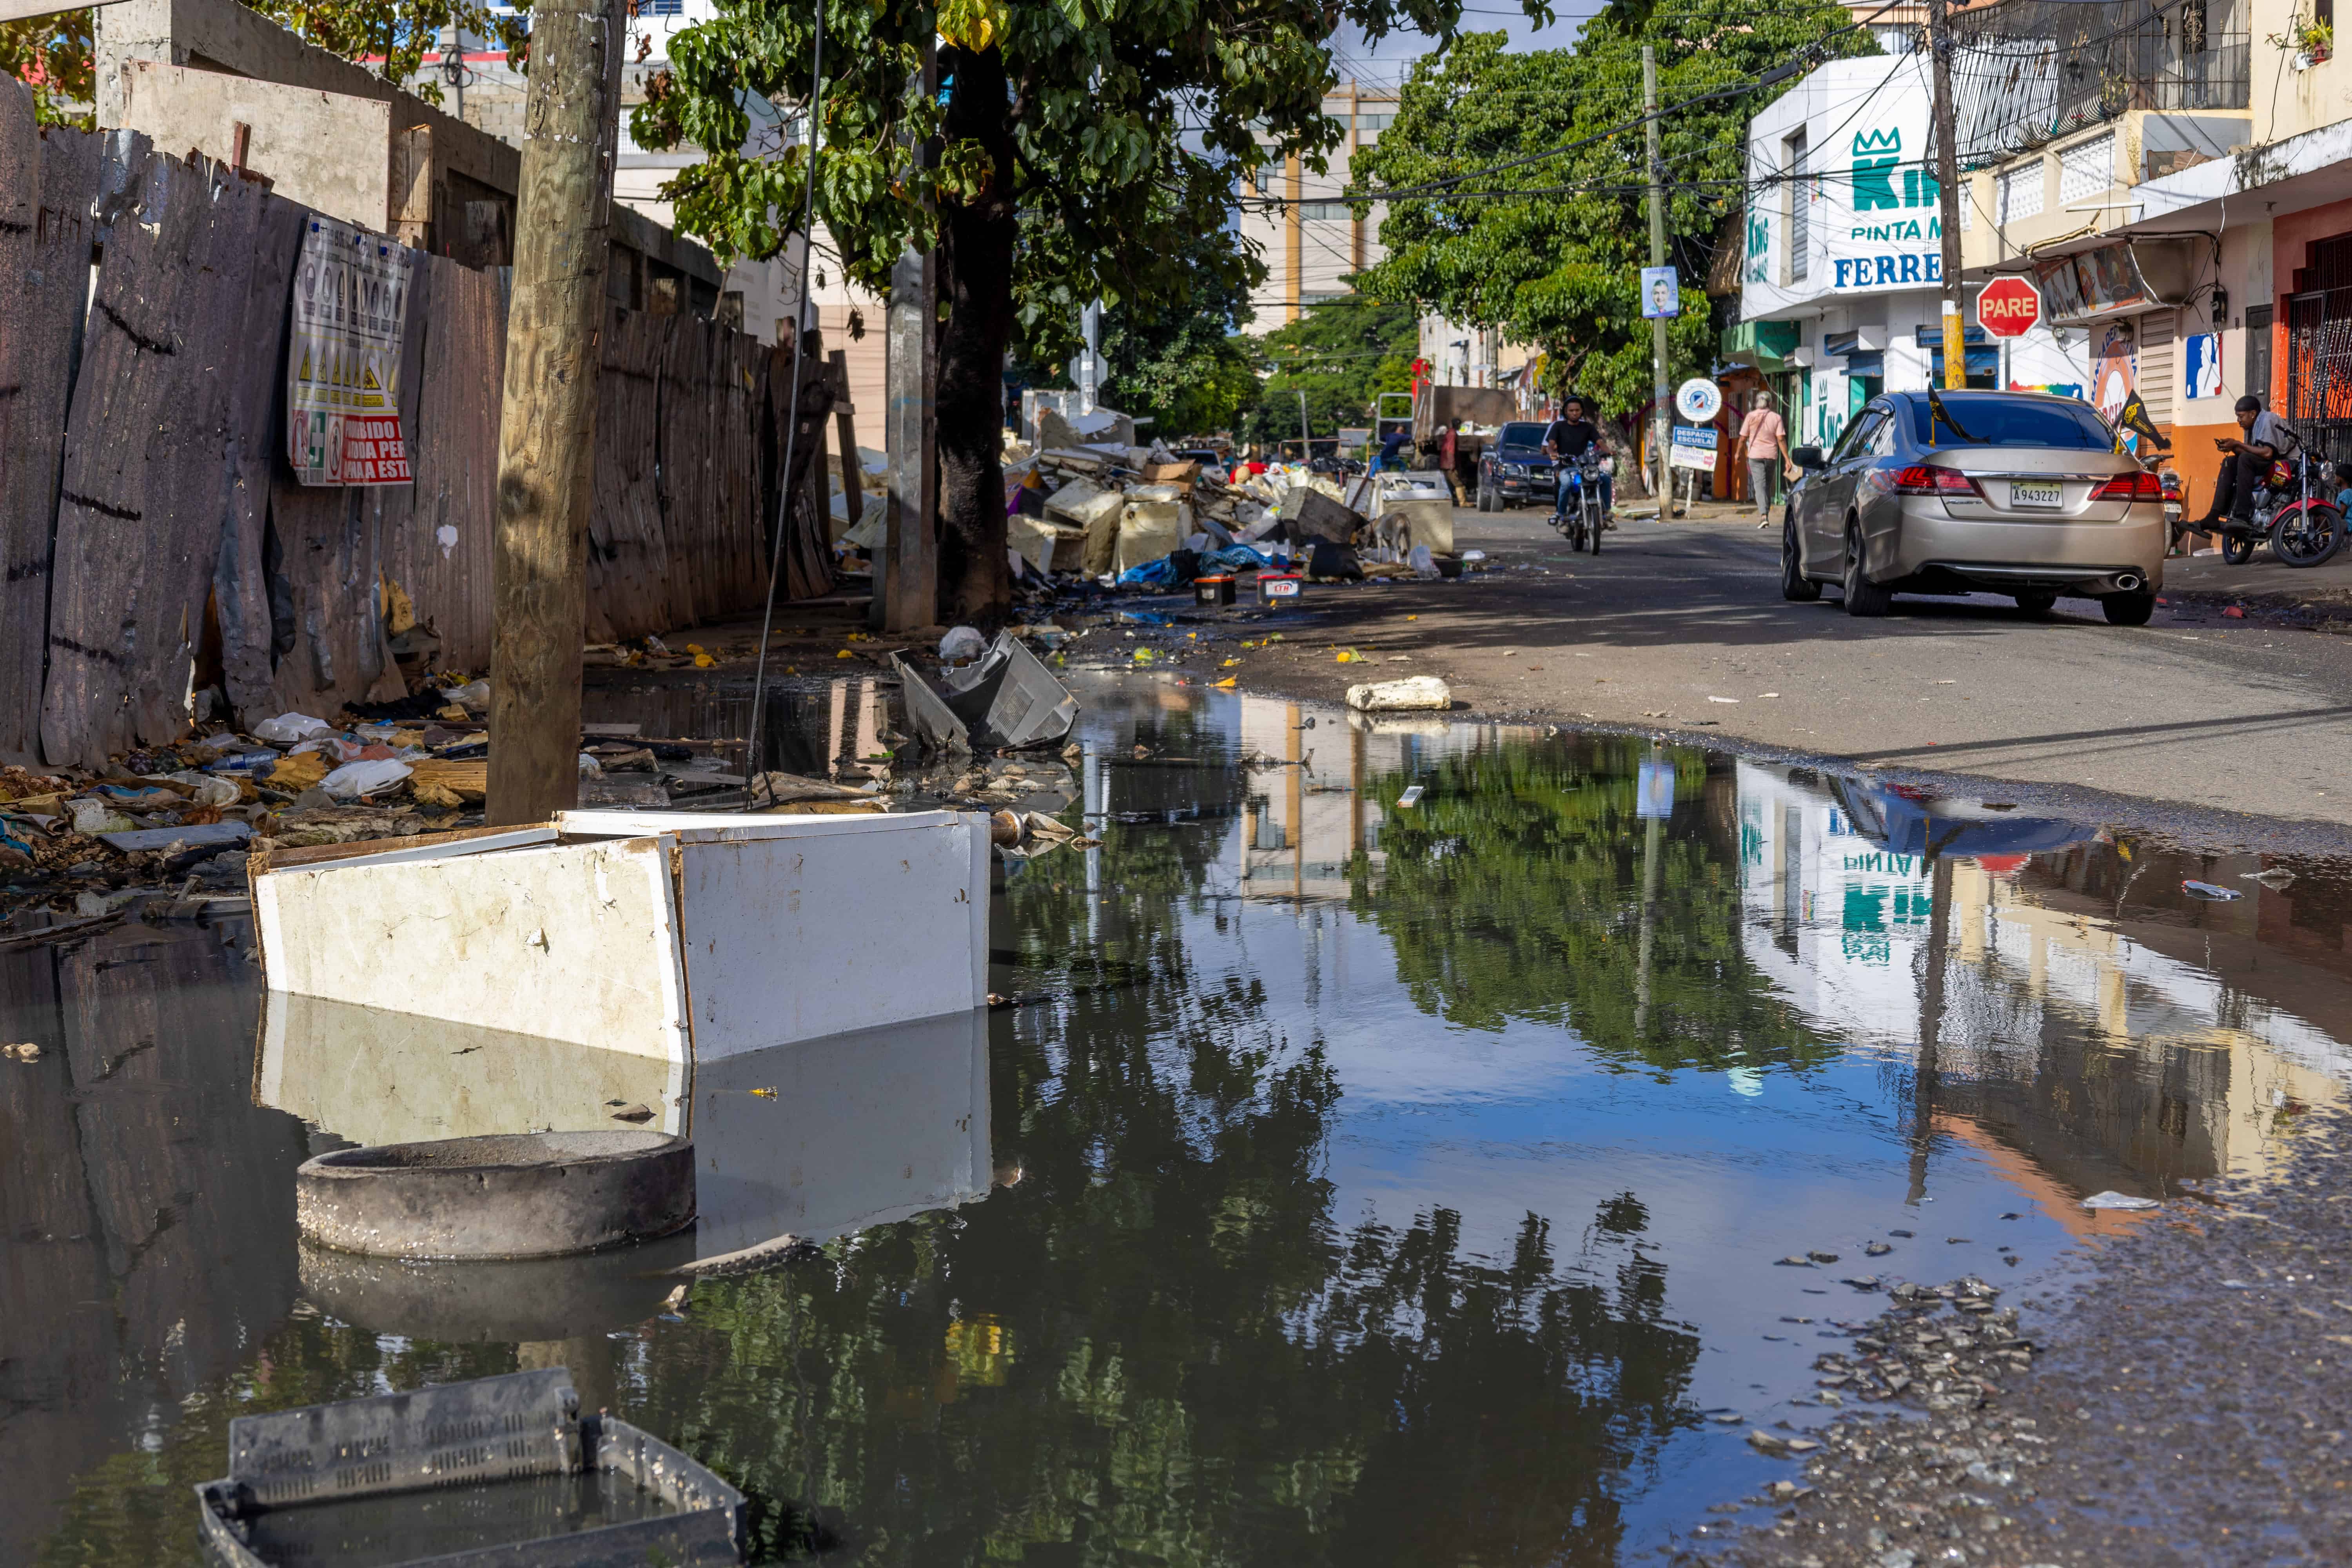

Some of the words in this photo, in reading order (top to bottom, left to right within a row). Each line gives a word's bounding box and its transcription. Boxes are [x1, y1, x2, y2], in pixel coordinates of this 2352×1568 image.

[1851, 219, 1921, 242] PINTA
[1982, 297, 2035, 318] PARE
[1677, 429, 1713, 439] DESPACIO
[1677, 436, 1711, 445] ESCUELA
[365, 461, 376, 478] A
[2014, 490, 2060, 502] A943227
